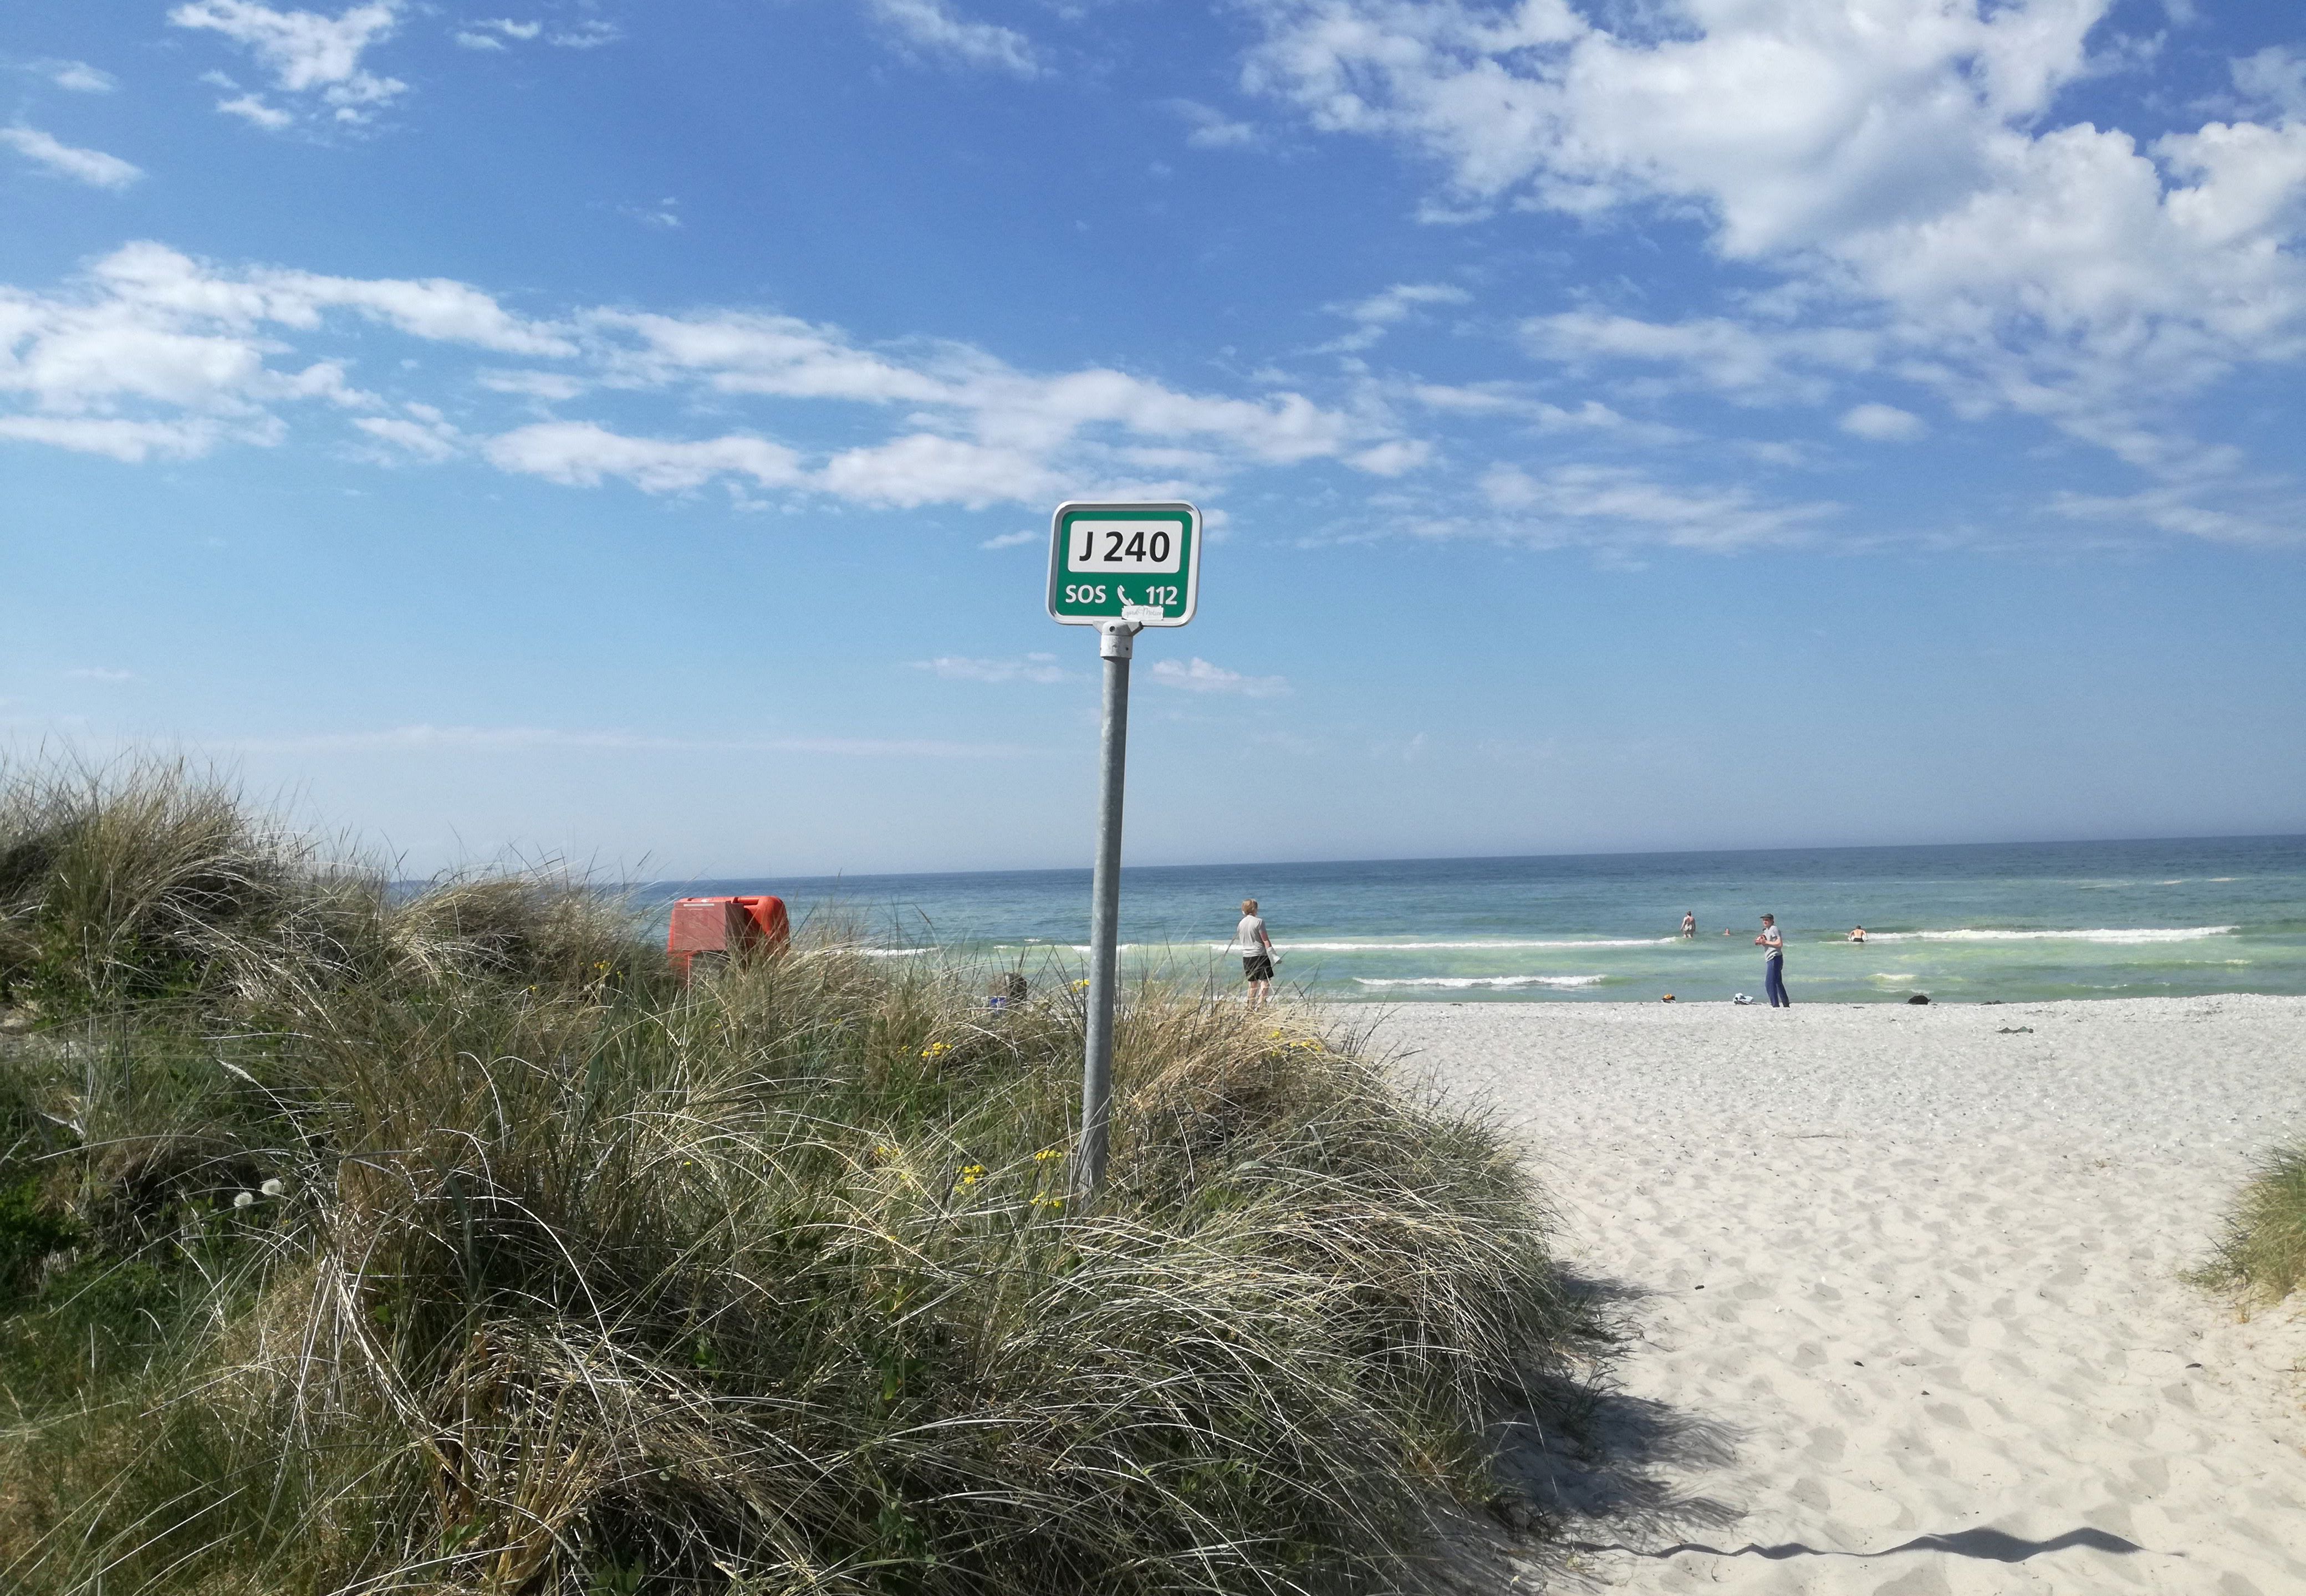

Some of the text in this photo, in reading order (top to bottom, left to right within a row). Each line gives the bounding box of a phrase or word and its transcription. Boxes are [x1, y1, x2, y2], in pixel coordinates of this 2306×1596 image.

[1079, 531, 1170, 562] J 240
[1065, 585, 1178, 605] SOS 112
